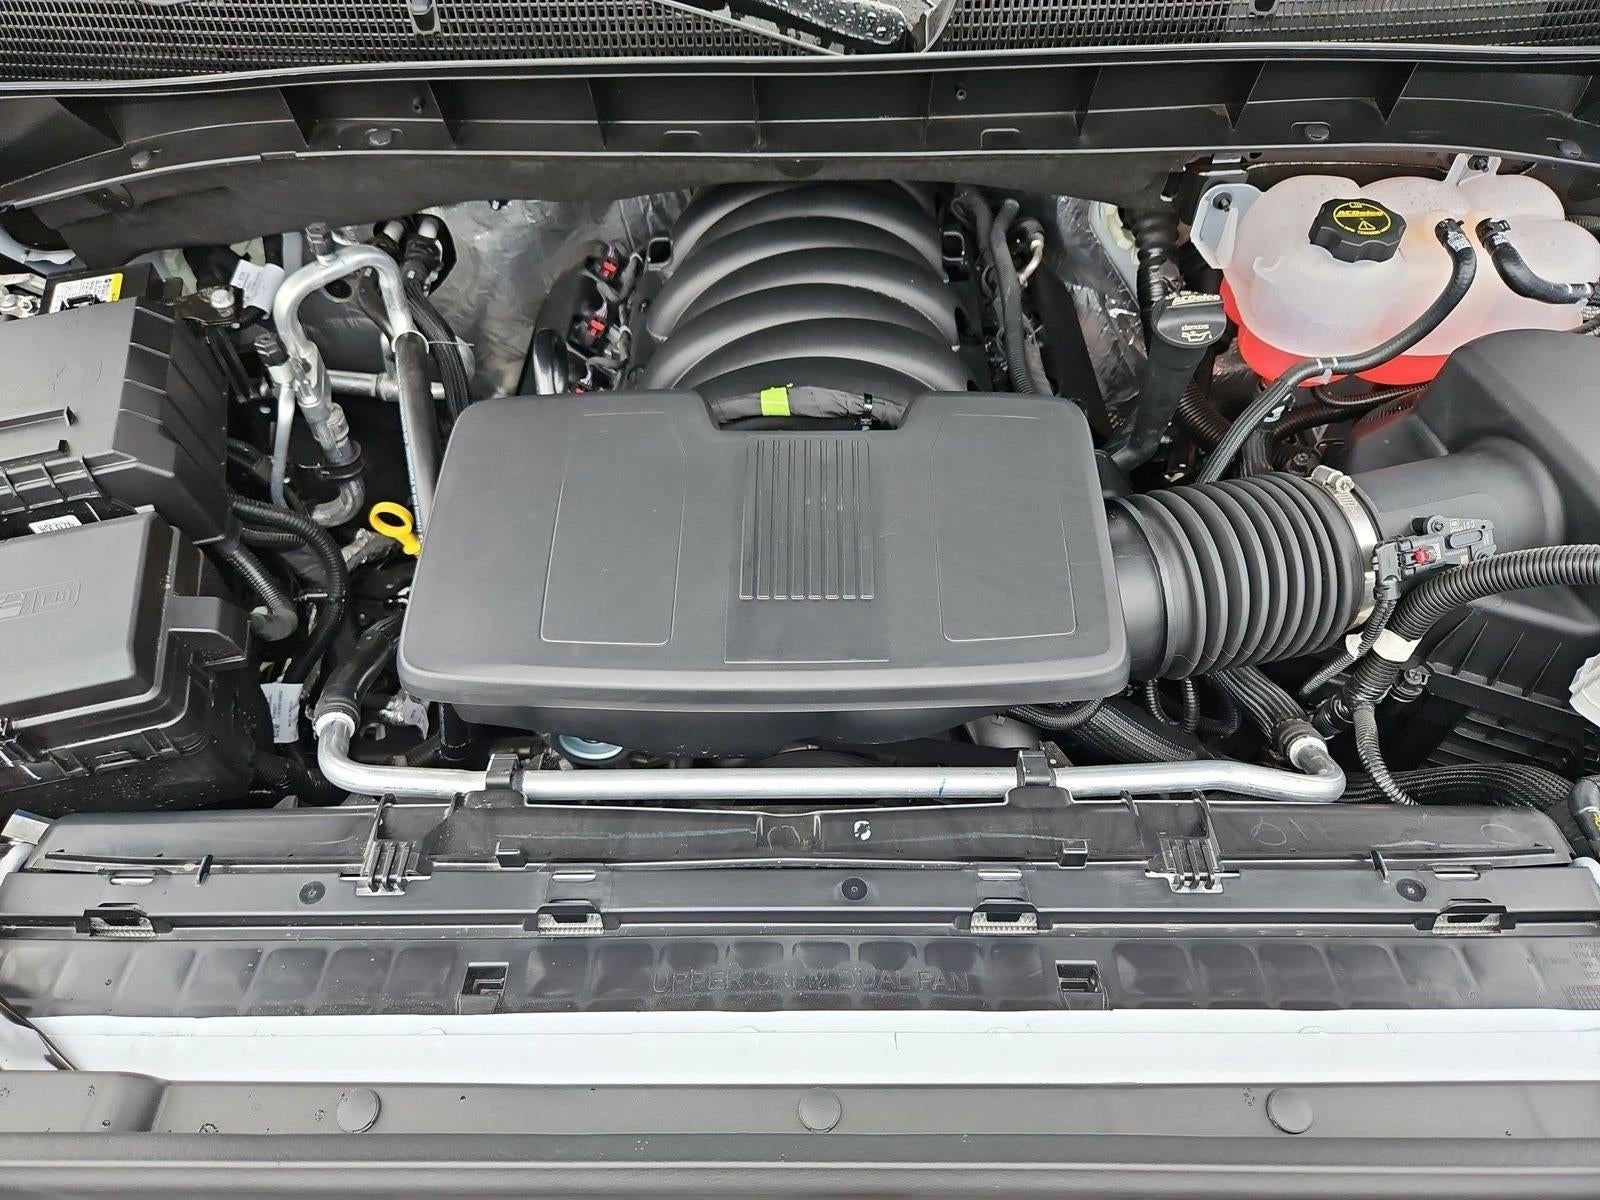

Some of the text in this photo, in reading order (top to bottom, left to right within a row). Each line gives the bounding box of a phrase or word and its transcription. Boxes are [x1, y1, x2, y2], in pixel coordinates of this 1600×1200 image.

[1171, 293, 1221, 306] ACDelco
[1181, 323, 1210, 331] dexos
[652, 968, 744, 993] UPPER
[838, 968, 911, 991] DUAL
[917, 969, 971, 993] FAN
